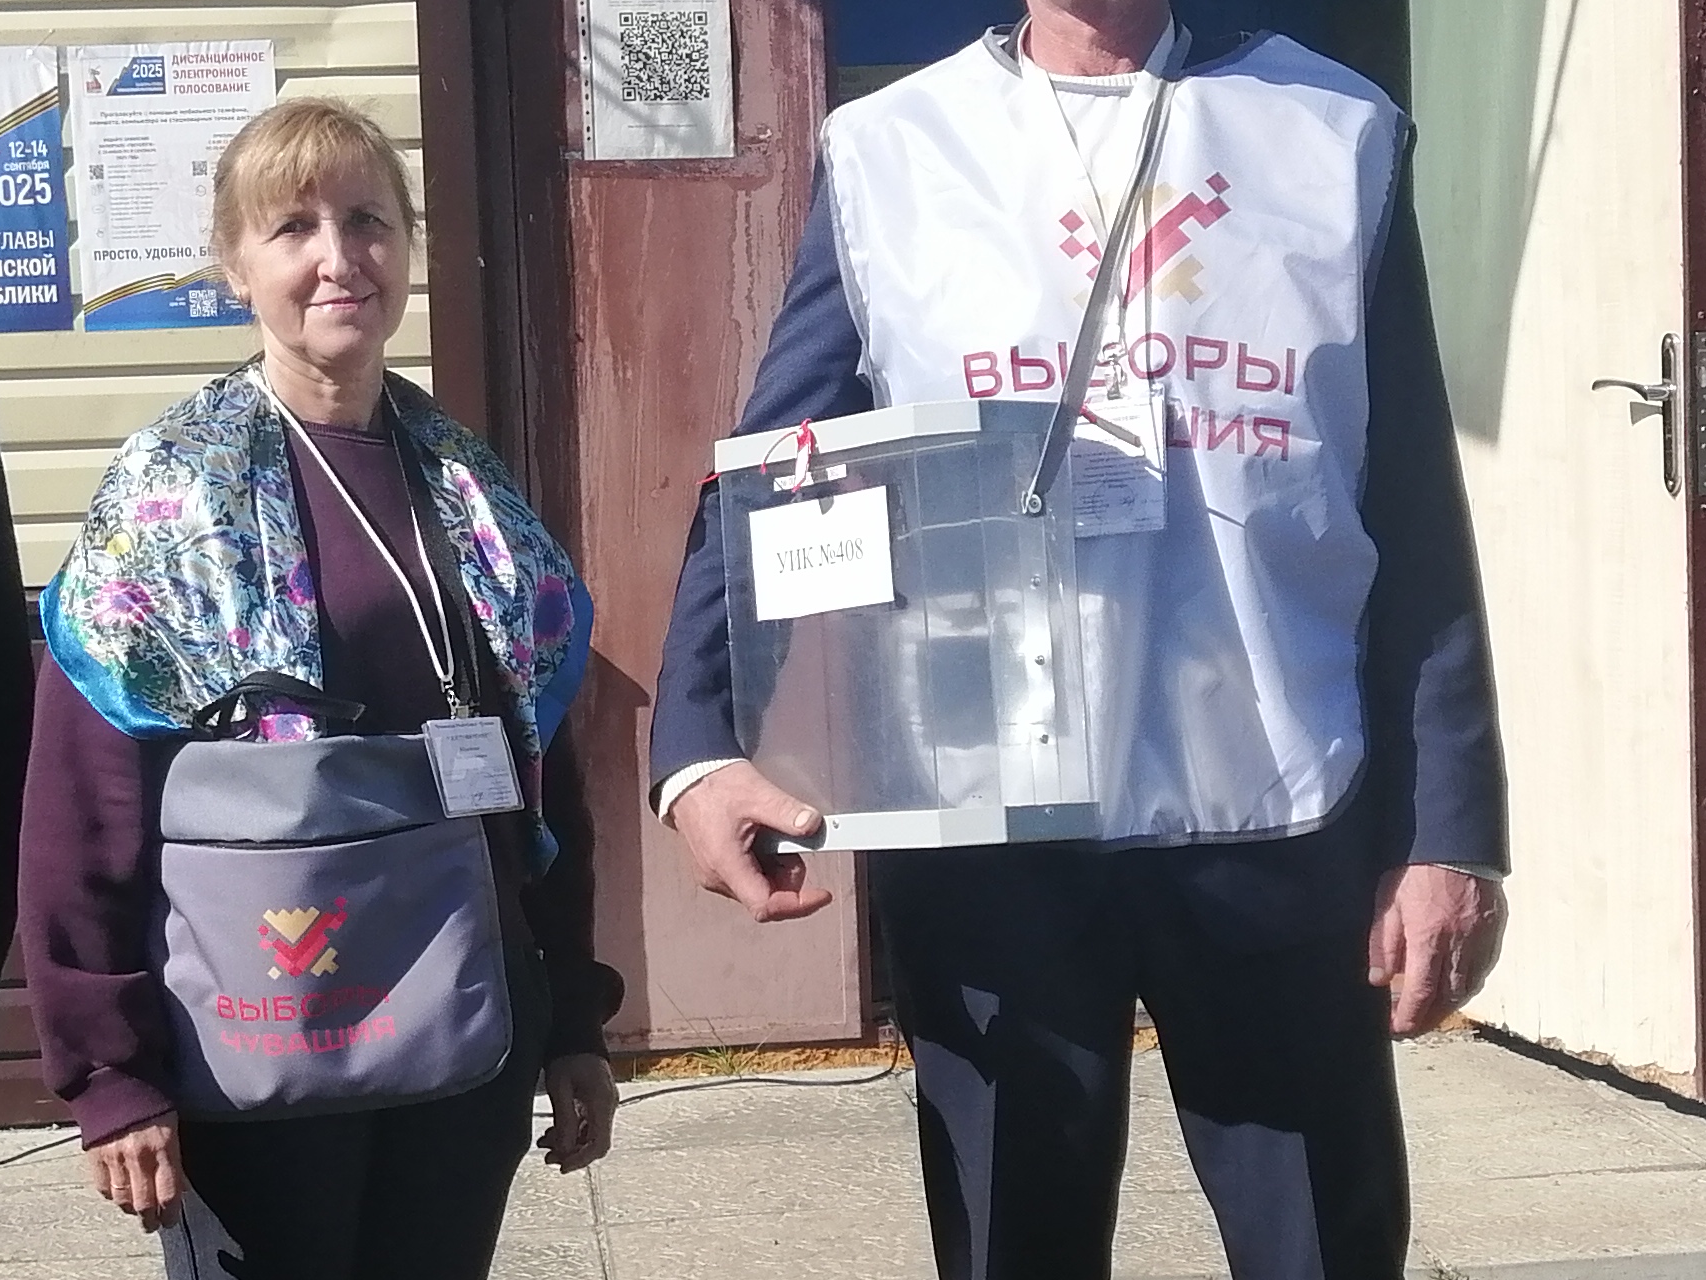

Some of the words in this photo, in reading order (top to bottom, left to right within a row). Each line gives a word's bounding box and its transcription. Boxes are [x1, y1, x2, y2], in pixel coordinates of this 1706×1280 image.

[171, 52, 265, 66] ДИСТАНЦИОННОЕ
[132, 64, 163, 78] 2025
[172, 68, 248, 80] ЭЛЕКТРОННОЕ
[173, 82, 251, 94] ГОЛОСОВАНИЕ
[9, 139, 48, 159] 12-14
[3, 158, 50, 172] сентября
[94, 248, 142, 261] ПРОСТО,
[145, 247, 196, 260] УДОБНО,
[963, 332, 1297, 399] ВЫОРЫ
[776, 546, 814, 574] УИК
[216, 985, 390, 1022] ВЫБОРЫ
[220, 1015, 396, 1057] ЧУВАШИЯ
